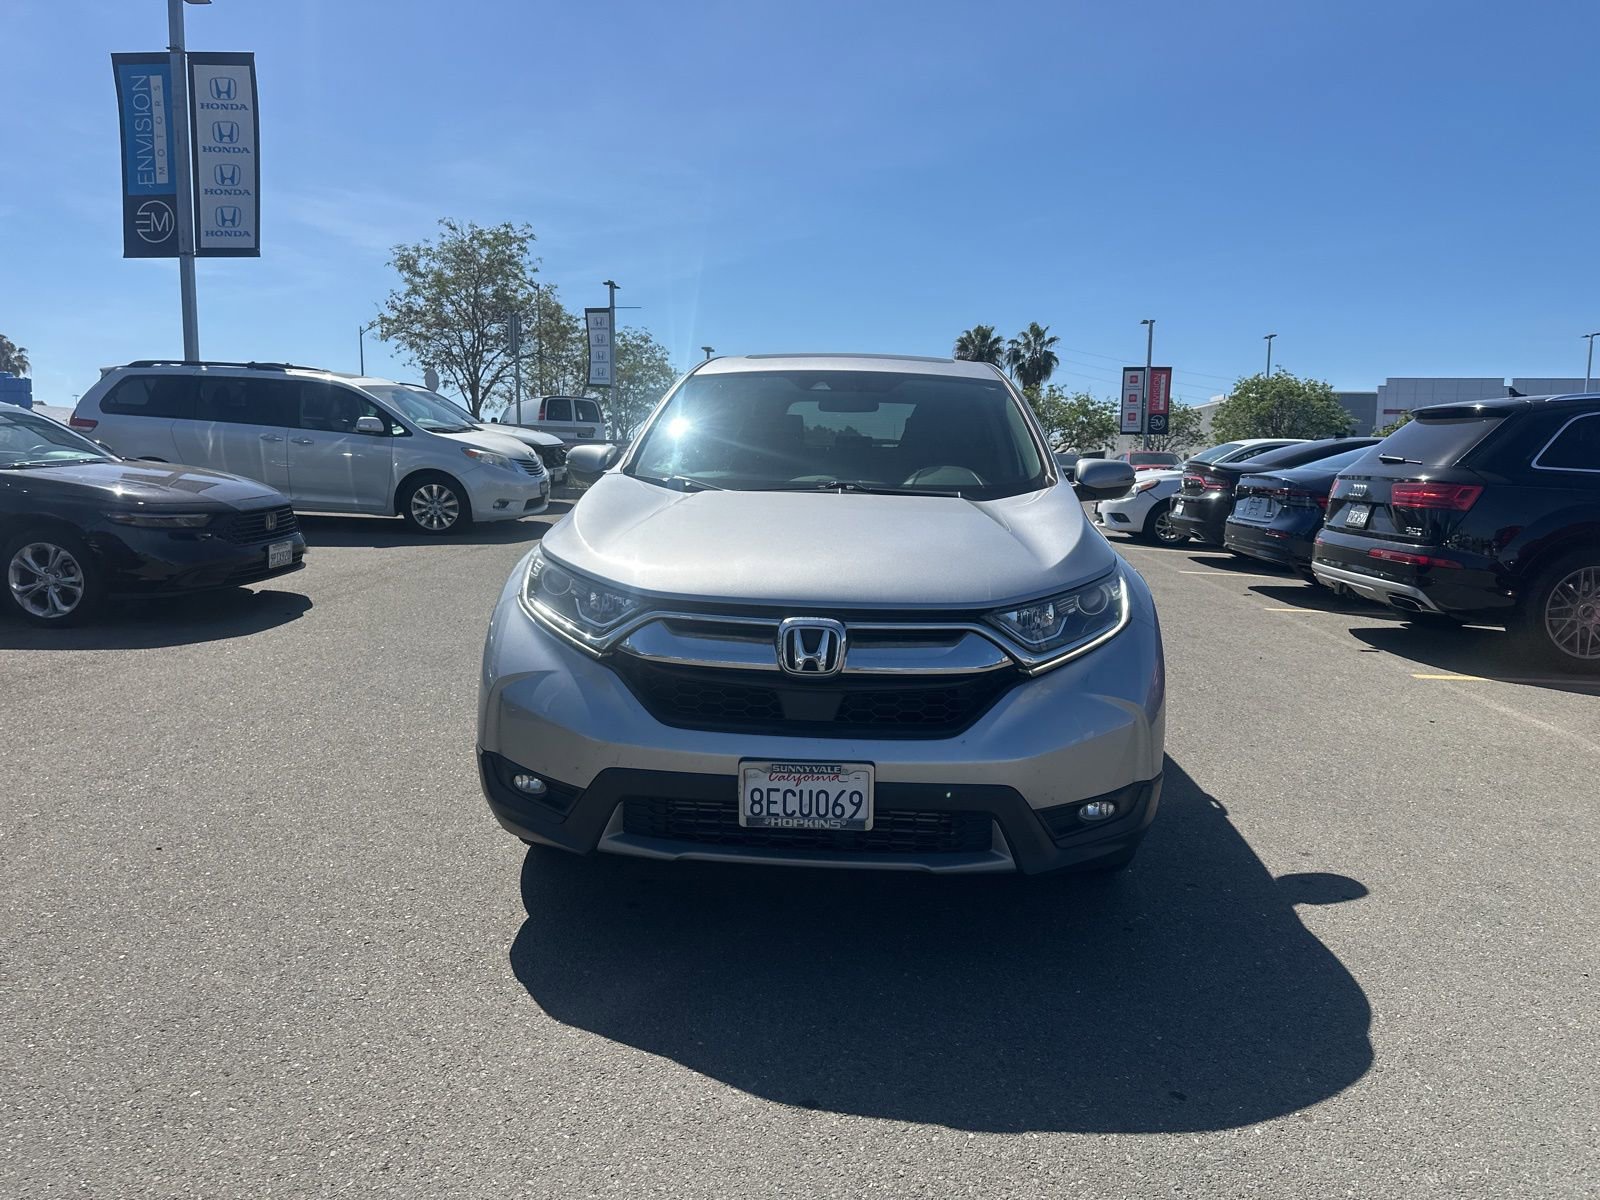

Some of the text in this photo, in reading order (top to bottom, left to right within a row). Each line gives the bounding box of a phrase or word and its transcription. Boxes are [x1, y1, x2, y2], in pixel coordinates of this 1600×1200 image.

[200, 102, 249, 111] HONDA
[130, 75, 155, 185] ENVISION
[153, 84, 166, 176] MOTORS
[202, 145, 251, 154] HONDA
[204, 188, 252, 196] HONDA
[205, 229, 251, 238] HONDA
[772, 764, 841, 774] SUNNYVALE
[768, 773, 843, 787] California
[750, 787, 864, 819] 8ECU069
[770, 818, 841, 829] HOPKINS
